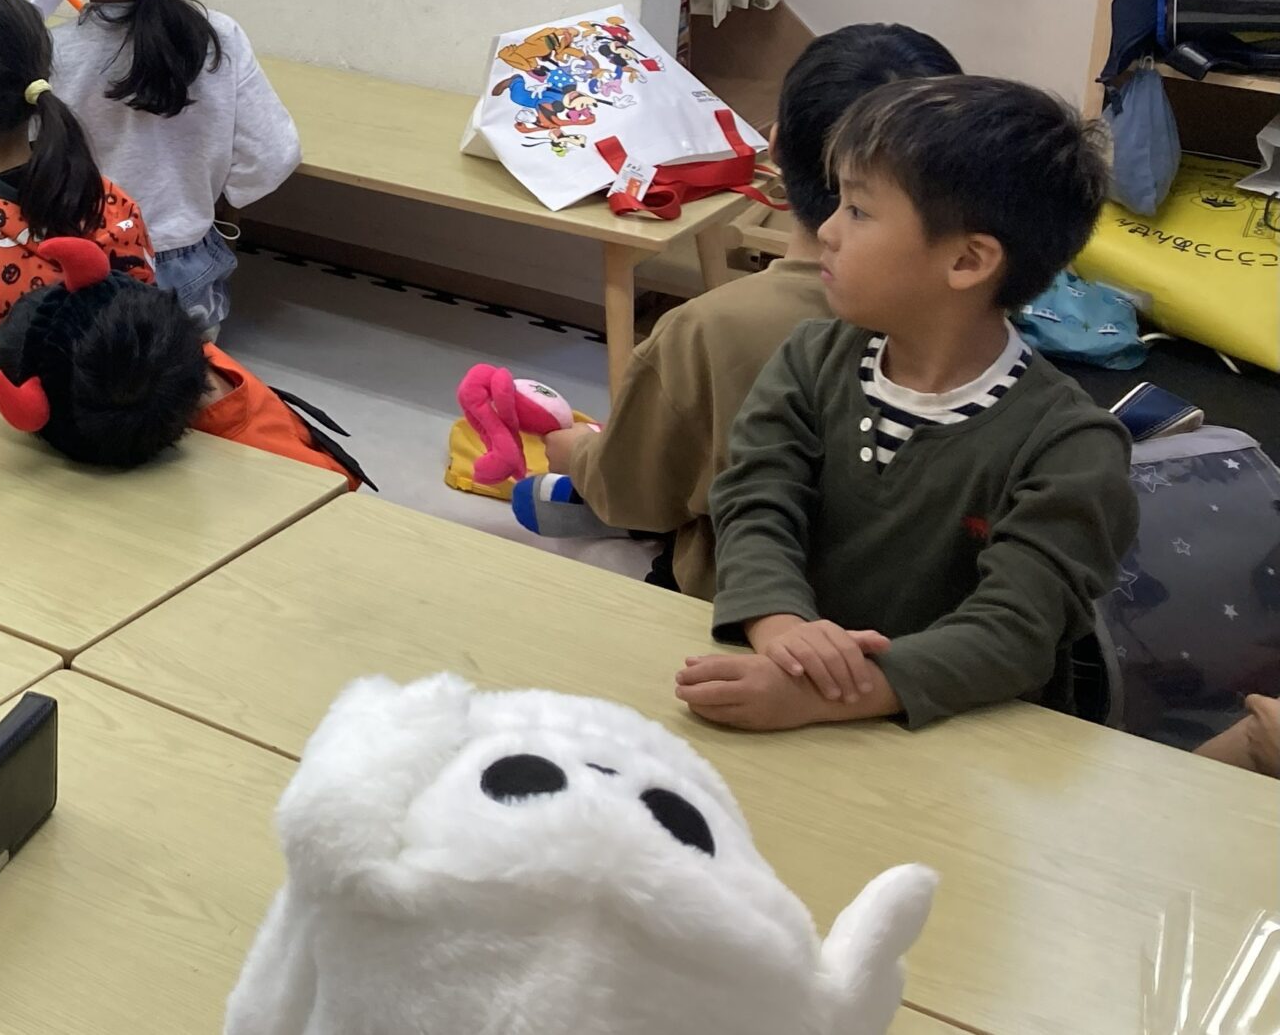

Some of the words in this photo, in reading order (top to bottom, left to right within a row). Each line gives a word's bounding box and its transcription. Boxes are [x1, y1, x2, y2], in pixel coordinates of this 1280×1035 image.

[1115, 217, 1279, 267] こうつうあんぜん
